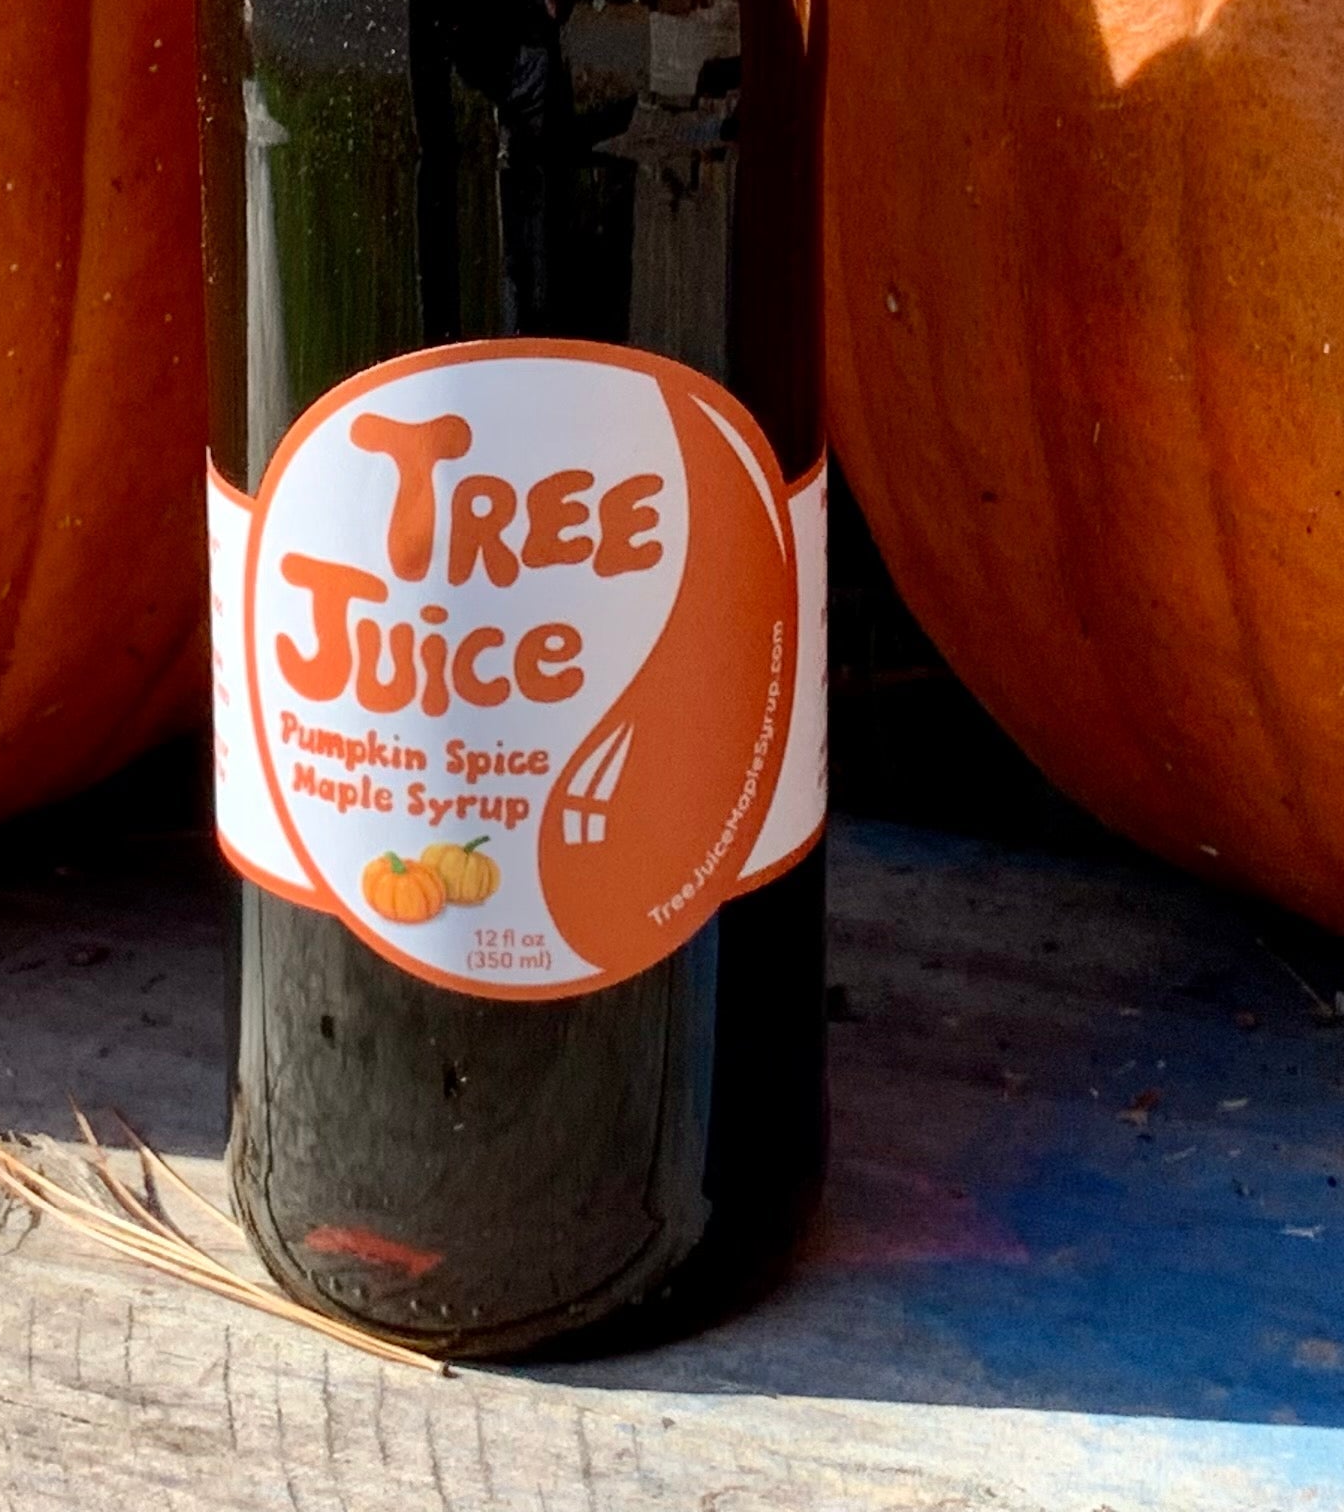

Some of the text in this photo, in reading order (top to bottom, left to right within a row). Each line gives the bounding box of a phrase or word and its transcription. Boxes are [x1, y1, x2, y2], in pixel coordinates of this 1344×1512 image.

[275, 552, 585, 717] Juice
[280, 711, 427, 771] Pumpkin
[446, 739, 550, 784] Spice
[647, 620, 784, 926] TreeJuiceMapleSyrup.com
[293, 762, 530, 829] Maple Syrup
[466, 951, 552, 969] (350 ml)
[473, 929, 545, 947] 12 fl oz
